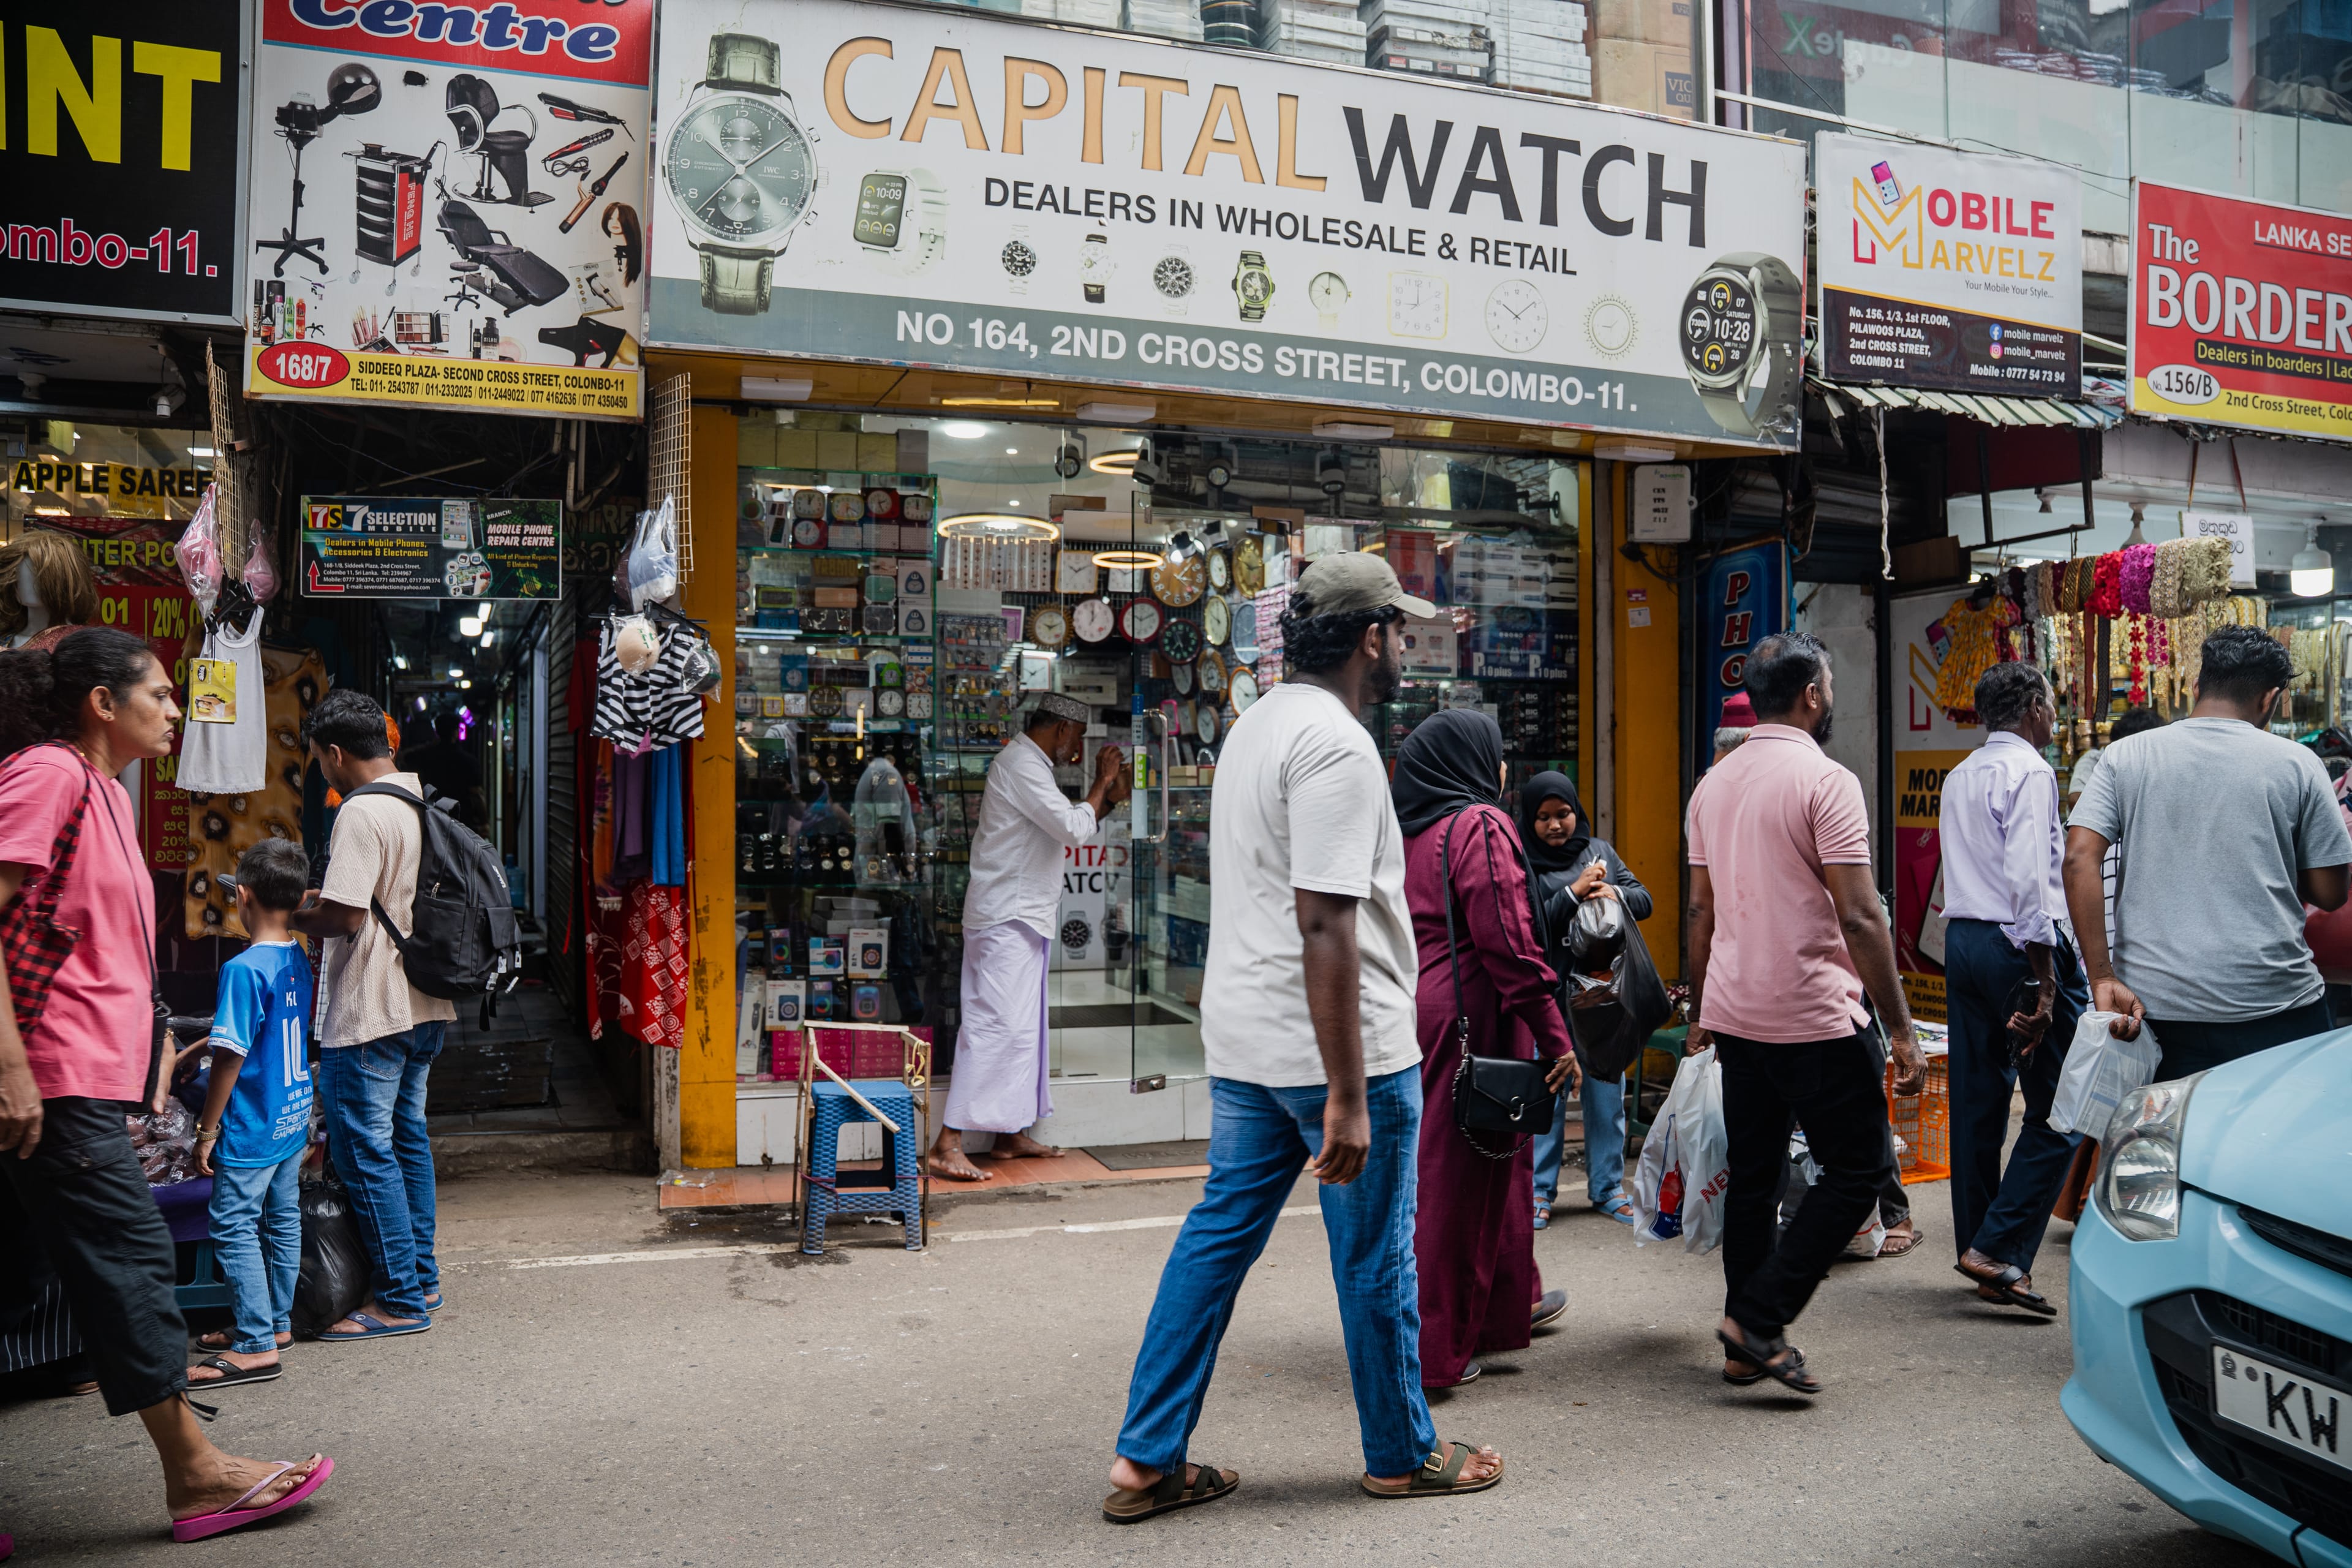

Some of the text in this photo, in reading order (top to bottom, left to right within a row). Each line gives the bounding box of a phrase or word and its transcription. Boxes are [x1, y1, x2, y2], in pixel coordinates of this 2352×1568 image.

[0, 20, 221, 172] NT
[823, 36, 1708, 248] CAPITAL WATCH
[876, 187, 902, 200] 10:09
[985, 177, 1577, 276] DEALERS IN WHOLESALE & RETAIL
[0, 217, 217, 277] mbo-11.
[2148, 222, 2199, 265] The
[2254, 220, 2322, 251] LANKA
[1965, 279, 2054, 298] Your Mobile Your Style...
[1736, 298, 1745, 307] 07
[2147, 263, 2352, 354] BORDER
[1726, 311, 1751, 319] SATURDAY
[1849, 306, 1950, 329] No. 156, 1/3, 1st FLOOR,
[1714, 318, 1751, 342] 10:28
[1849, 322, 1924, 341] PILAWOOS PLAZA,
[2004, 328, 2064, 344] mobile marvelz
[1730, 350, 1740, 360] 28
[1850, 337, 1931, 358] 2nd CROSS STREET,
[2004, 345, 2065, 360] mobile_marvelz
[2198, 342, 2247, 365] Dealers
[2251, 350, 2263, 366] in
[2267, 352, 2322, 375] boarders
[276, 353, 331, 382] 168/7
[896, 311, 1637, 412] NO 164, 2ND CROSS STREET, COLOMBO-11.
[1850, 353, 1905, 369] COLOMBO 11
[358, 361, 624, 391] SIDDEEQ PLAZA- SECOND CROSS STREET, COLONBO-11
[2007, 369, 2027, 380] 0777
[2029, 370, 2040, 381] 54
[2041, 371, 2053, 382] 73
[2054, 372, 2065, 383] 94
[2152, 371, 2212, 396] No. 156/B
[350, 378, 628, 409] TEL: 011- 2543787 011-2332025 011-2449022 077 4162636 077 4350450
[2226, 392, 2248, 407] 2nd
[2252, 396, 2283, 412] Cross
[2286, 400, 2326, 418] Street,
[13, 460, 109, 494] APPLE
[119, 466, 214, 498] SAREE
[367, 512, 436, 526] SELECTION
[486, 509, 512, 520] BRANCH:
[487, 524, 553, 535] MOBILE PHONE
[323, 547, 373, 556] Accessories
[383, 549, 428, 557] Electronics
[325, 537, 427, 549] Dealers in Mobile Phones,
[487, 536, 555, 547] REPAIR CENTRE
[82, 540, 137, 567] TER
[102, 598, 184, 639] 01 20%
[2264, 1371, 2339, 1454] KW
